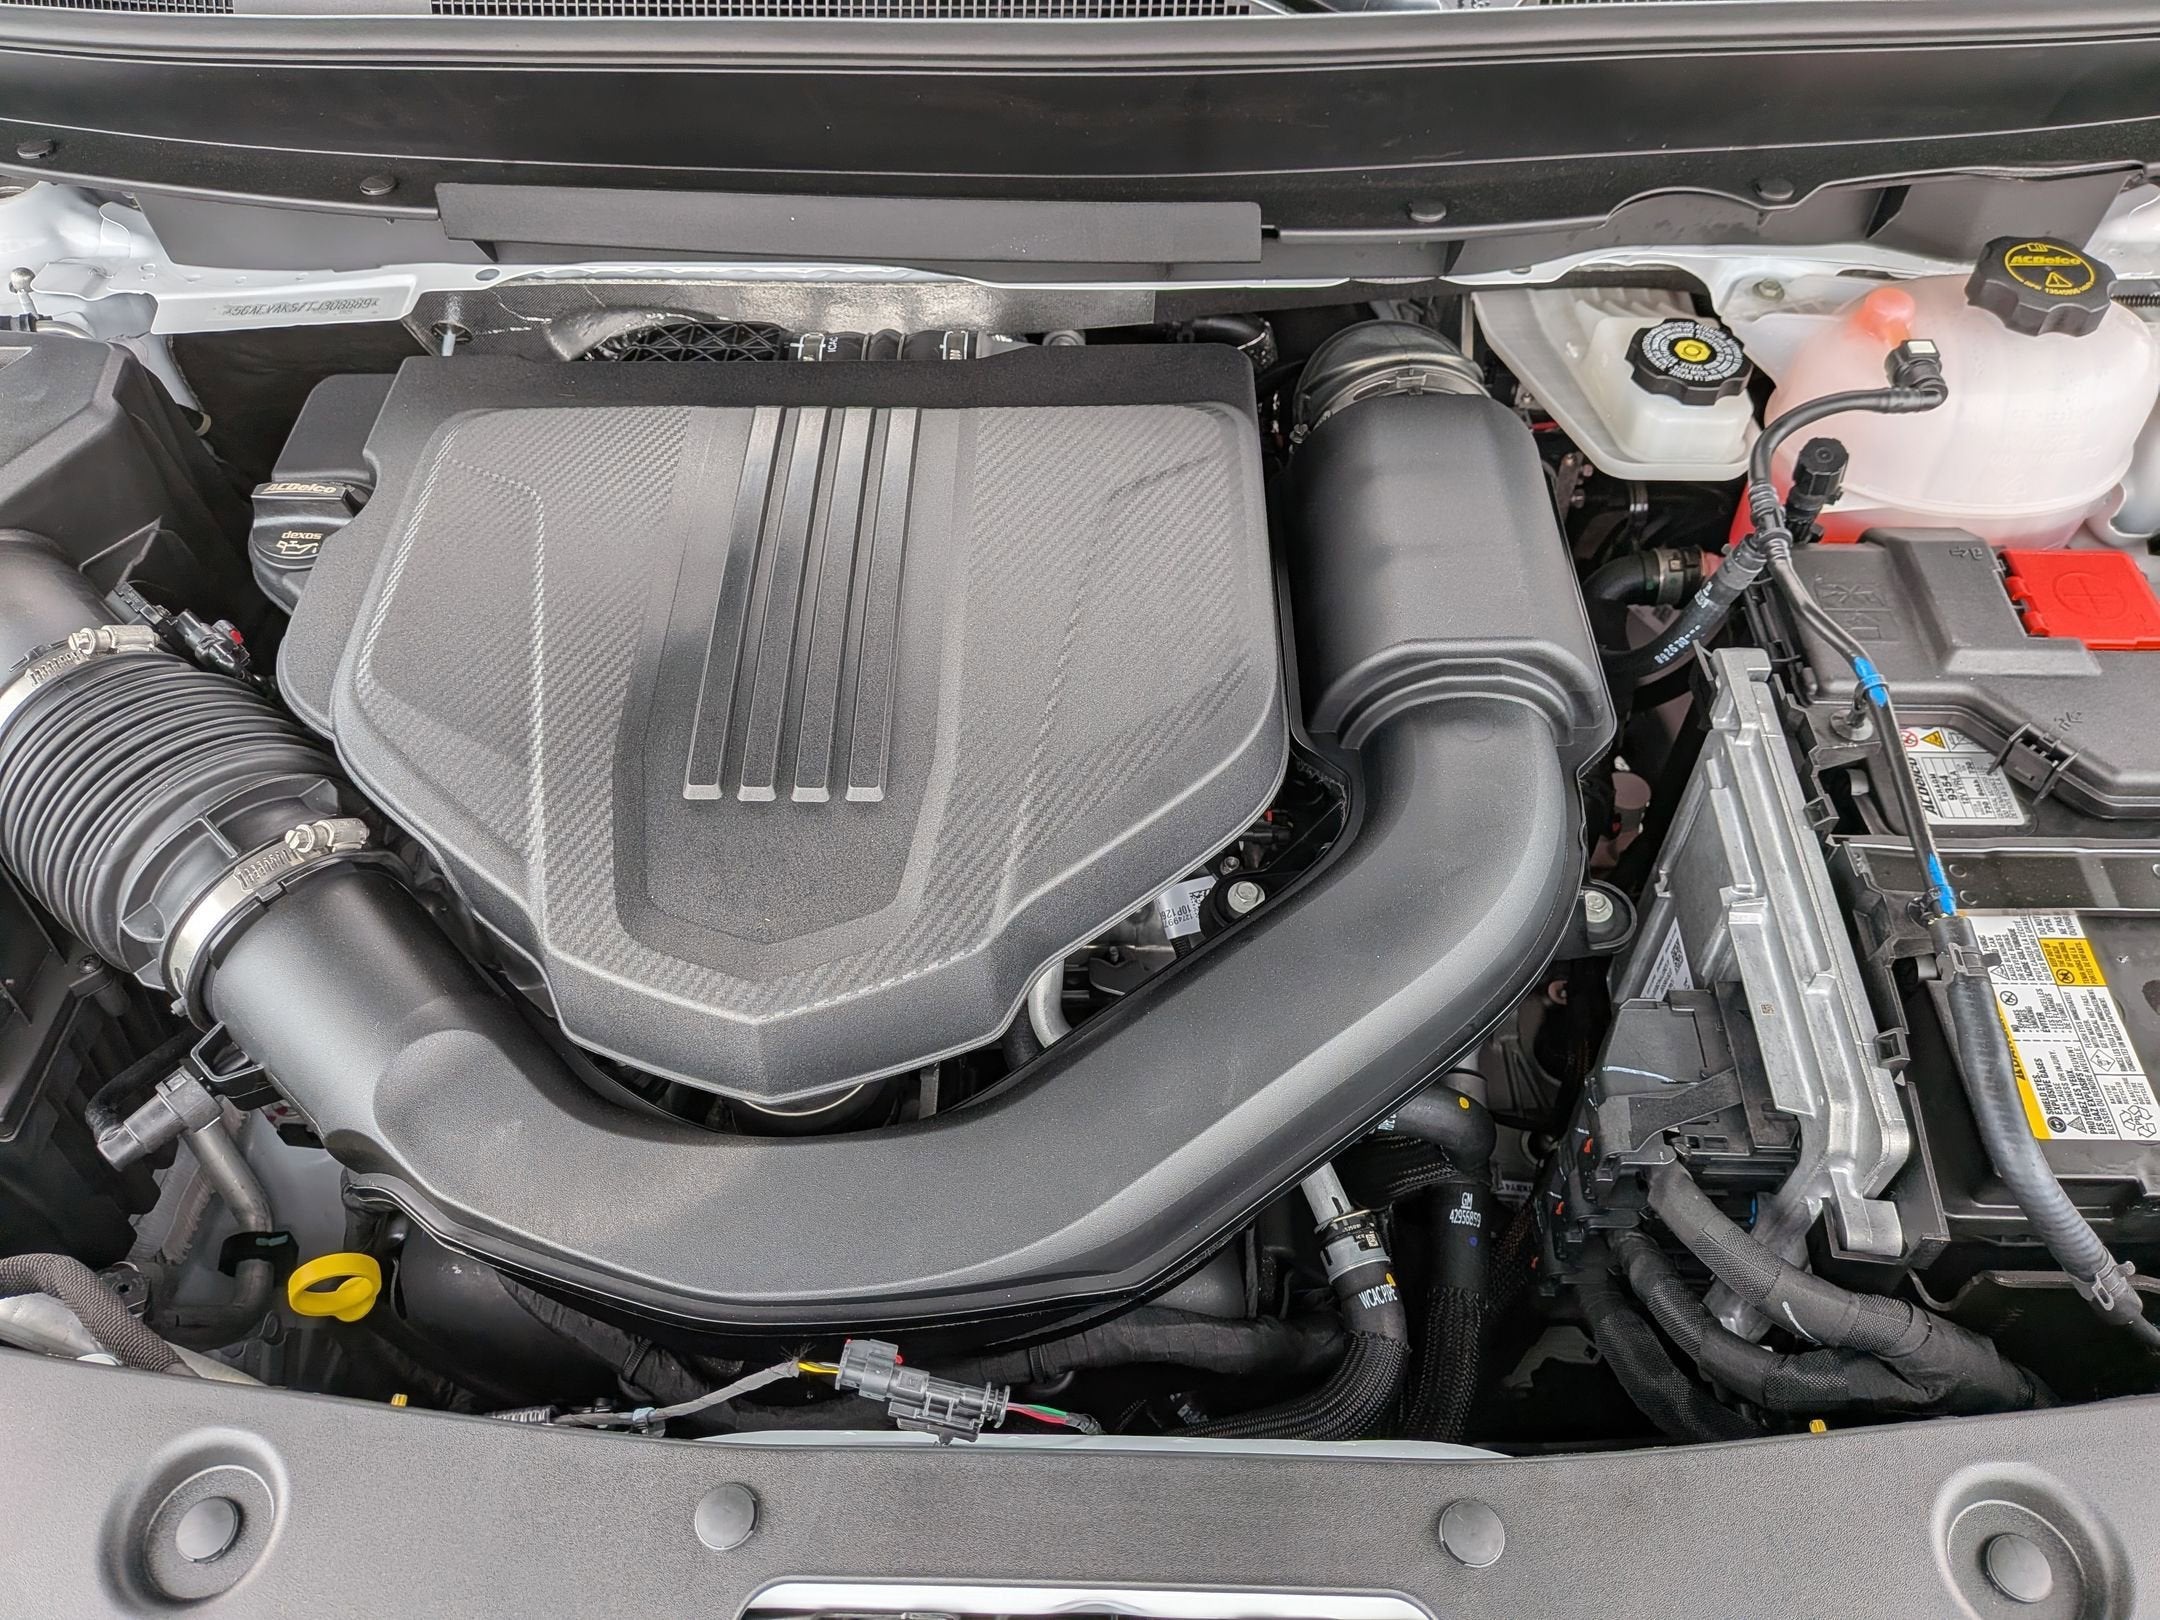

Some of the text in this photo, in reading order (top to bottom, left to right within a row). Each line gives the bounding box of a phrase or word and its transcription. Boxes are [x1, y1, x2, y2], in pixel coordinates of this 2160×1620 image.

[2010, 255, 2081, 265] ACDelco
[263, 482, 337, 494] ACDelco
[281, 530, 323, 540] dexos
[1939, 775, 1957, 800] 9354
[2034, 1058, 2062, 1114] EXPLOSIVE GASES
[2058, 1073, 2066, 1081] OR
[2085, 1075, 2099, 1096] RENDRE
[2032, 1073, 2054, 1114] SHIELD EYES.
[2053, 1083, 2071, 1114] CAN CAUSE
[2062, 1083, 2080, 1114] BLINDNESS
[2065, 1046, 2107, 1134] LES GAZ EXPLOSIFS PEUVENT
[2073, 1088, 2084, 1099] LES
[2099, 1108, 2115, 1134] BLESSER
[1461, 1192, 1473, 1209] GM
